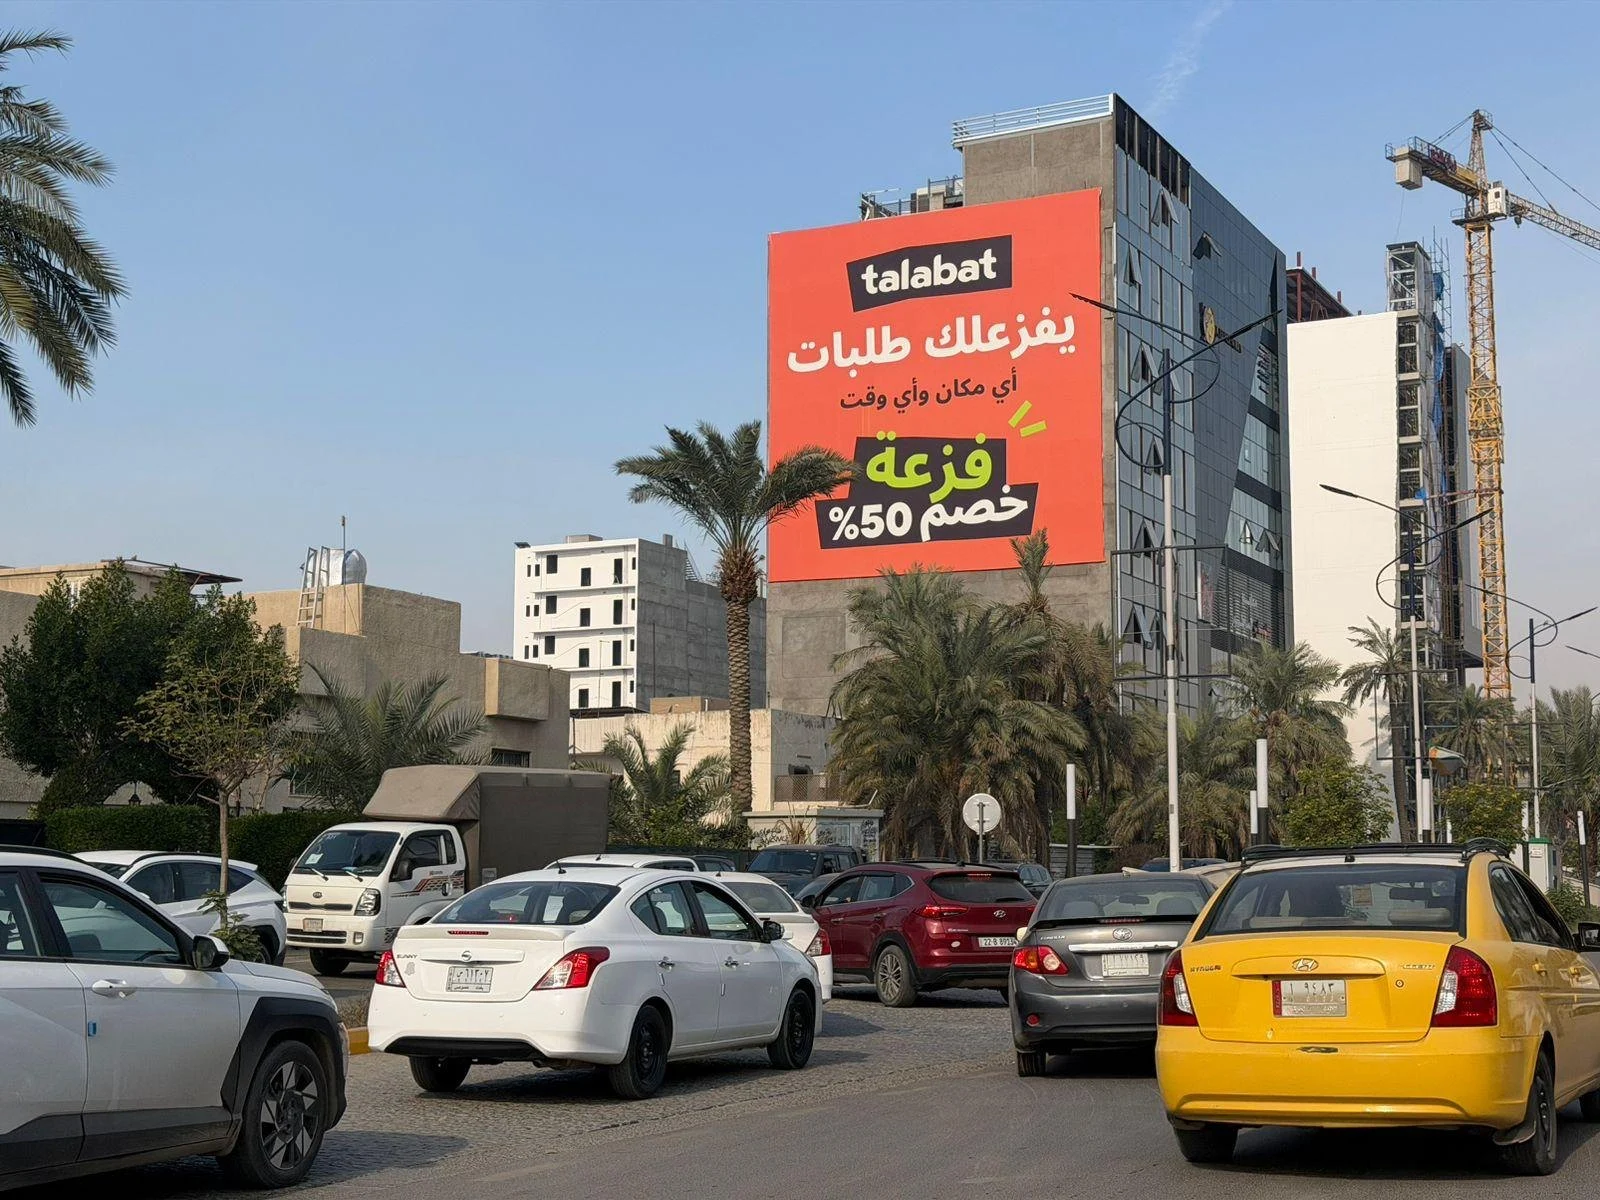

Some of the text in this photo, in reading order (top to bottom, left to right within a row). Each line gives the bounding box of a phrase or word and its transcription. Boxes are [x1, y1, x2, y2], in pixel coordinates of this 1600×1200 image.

[861, 248, 997, 295] talabat
[787, 306, 1076, 378] يفزعلك طلبات
[840, 366, 1017, 414] أي مكان وأي وقت
[866, 430, 992, 504] فزعة
[920, 484, 1029, 542] خصم
